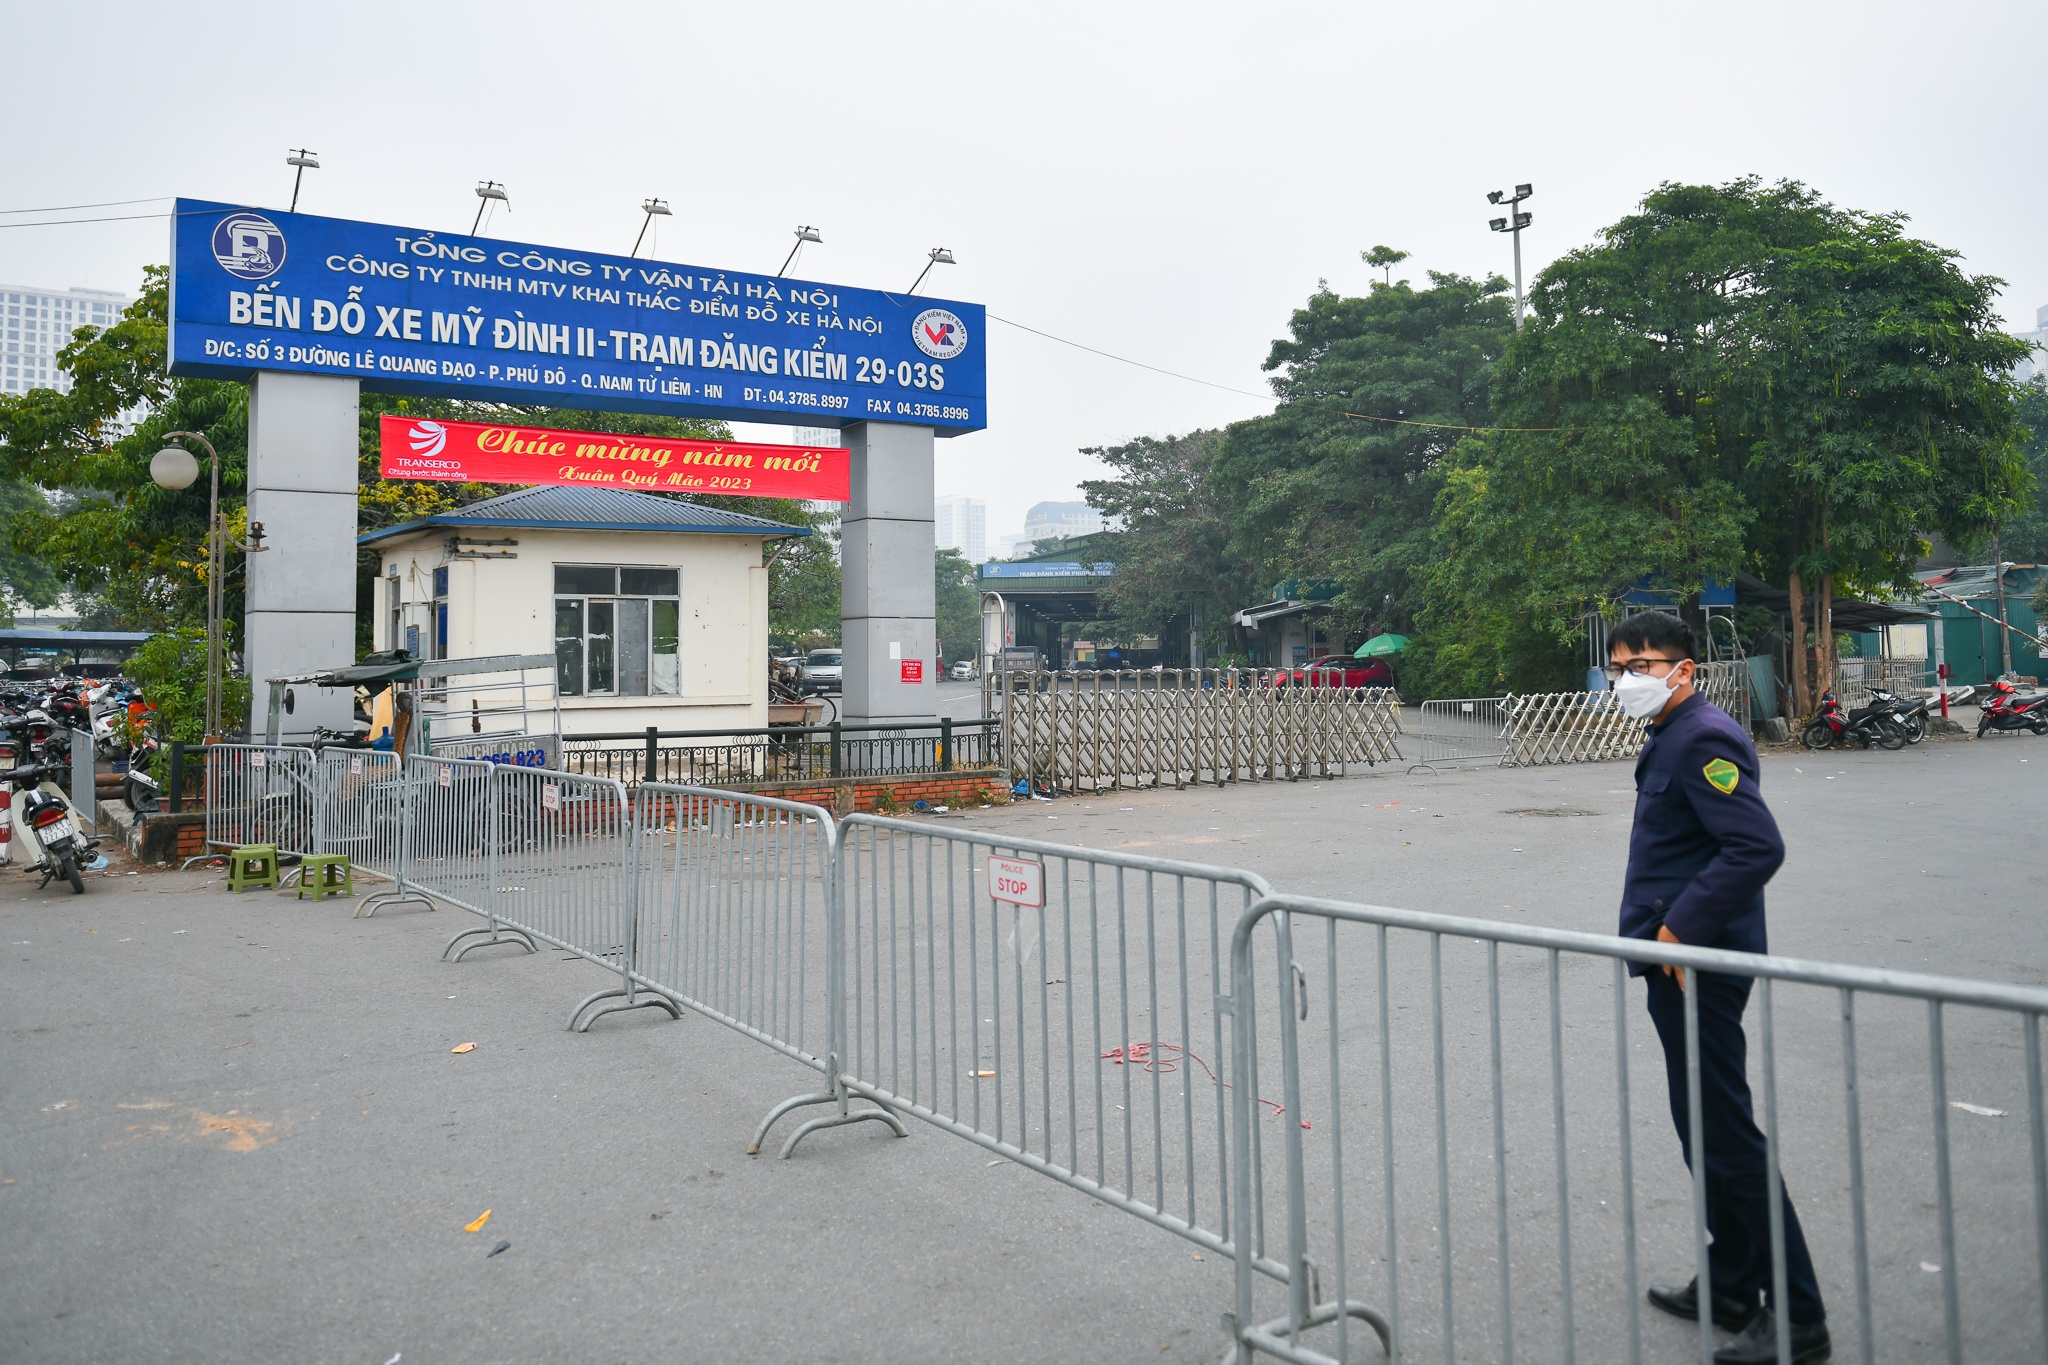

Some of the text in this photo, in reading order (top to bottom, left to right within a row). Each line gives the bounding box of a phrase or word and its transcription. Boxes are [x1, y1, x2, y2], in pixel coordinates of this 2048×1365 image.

[395, 232, 838, 310] TỔNG CÔNG TY VẬN TẢI HÀ NỘI
[326, 253, 882, 337] CÔNG TY TNHH MTV KHAI THÁC ĐIỂM ĐỖ XE HÀ NỘI
[229, 281, 300, 329] BẾN
[312, 286, 366, 335] ĐỖ
[375, 305, 421, 341] XE
[432, 306, 485, 346] MỸ
[493, 311, 570, 355] ĐÌNH
[699, 333, 778, 375] ĐĂNG
[785, 336, 847, 382] KIỂM
[855, 356, 945, 392] 29-03S
[954, 320, 966, 335] NAM
[915, 335, 965, 358] VIETNAM REGISTER
[205, 339, 242, 358] Đ/C:
[245, 338, 271, 360] SỐ
[274, 345, 285, 361] 3
[289, 344, 350, 368] ĐƯỜNG
[355, 349, 375, 369] LÊ
[379, 354, 437, 376] QUANG
[441, 360, 476, 382] ĐẠO
[543, 366, 567, 385] ĐÔ
[637, 373, 658, 394] TỪ
[661, 376, 691, 397] LIÊM
[704, 384, 723, 399] HN
[743, 387, 767, 403] ĐT:
[768, 389, 849, 409] 04.3785.8997
[867, 399, 892, 414] FAX
[896, 402, 970, 420] 04.3785.8996
[477, 429, 822, 473] Chúc mừng năm mới
[396, 457, 462, 470] TRANSERCO
[451, 471, 468, 480] công
[558, 465, 752, 490] Xuân Quý Mão 2023
[1001, 863, 1023, 874] POLICE
[998, 877, 1028, 895] STOP
